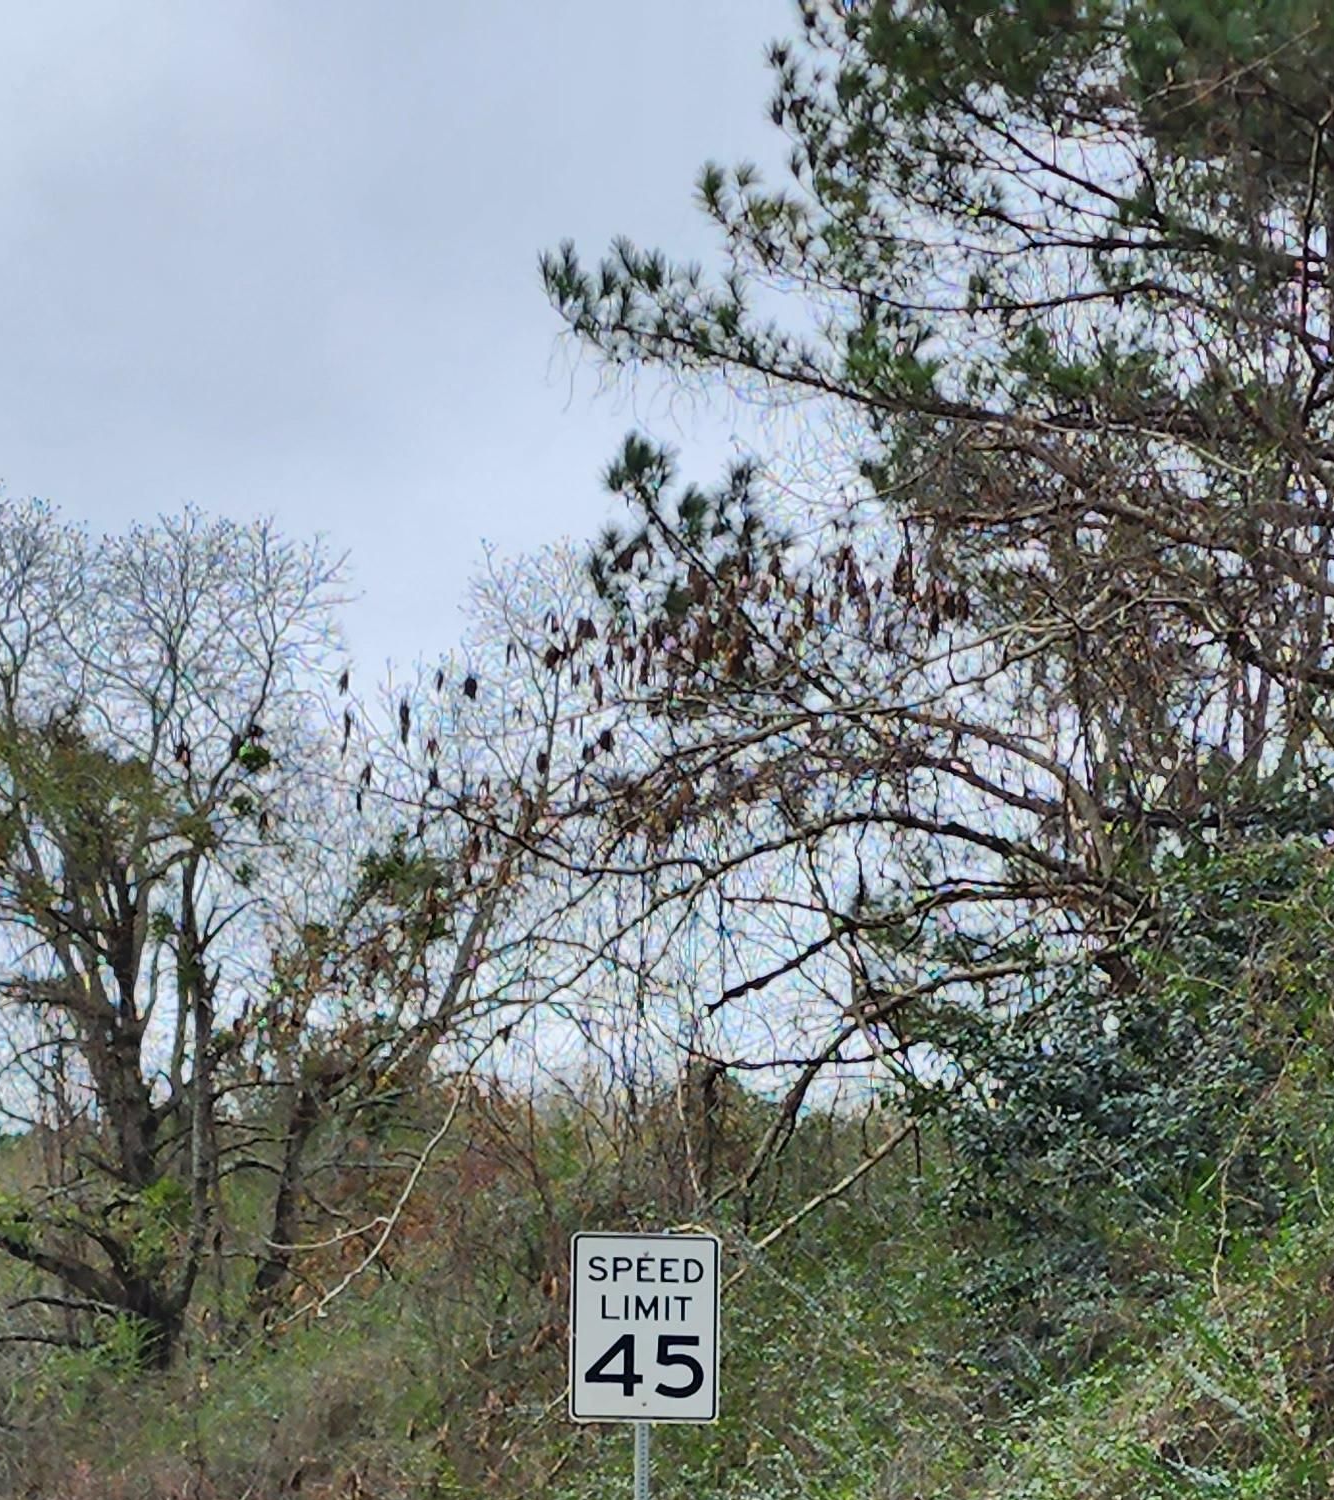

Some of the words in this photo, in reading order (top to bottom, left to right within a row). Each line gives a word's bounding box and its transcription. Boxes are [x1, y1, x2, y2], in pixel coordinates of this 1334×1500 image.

[588, 1256, 704, 1283] SPEED
[601, 1294, 693, 1321] LIMIT
[584, 1333, 704, 1399] 45
